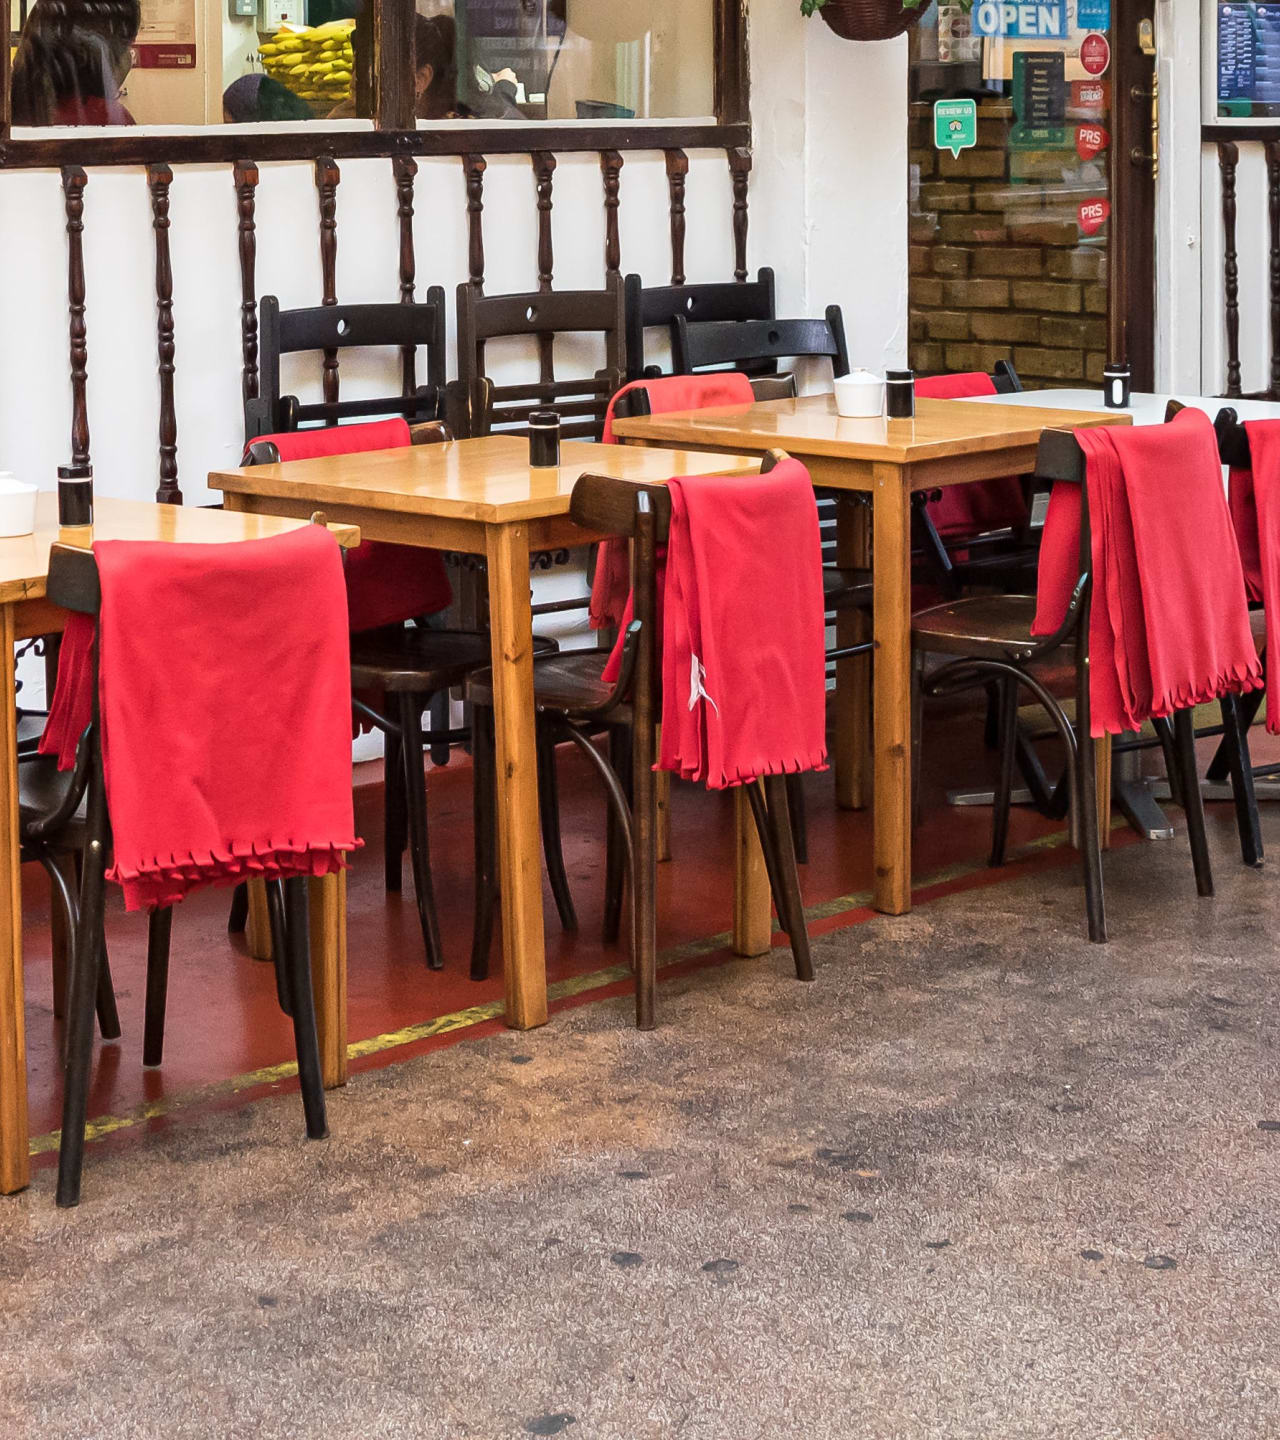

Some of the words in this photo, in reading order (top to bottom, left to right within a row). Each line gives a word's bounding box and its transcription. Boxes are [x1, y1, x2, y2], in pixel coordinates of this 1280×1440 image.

[977, 3, 1061, 35] OPEN
[1079, 128, 1102, 144] PRS
[1081, 203, 1103, 220] PRS
